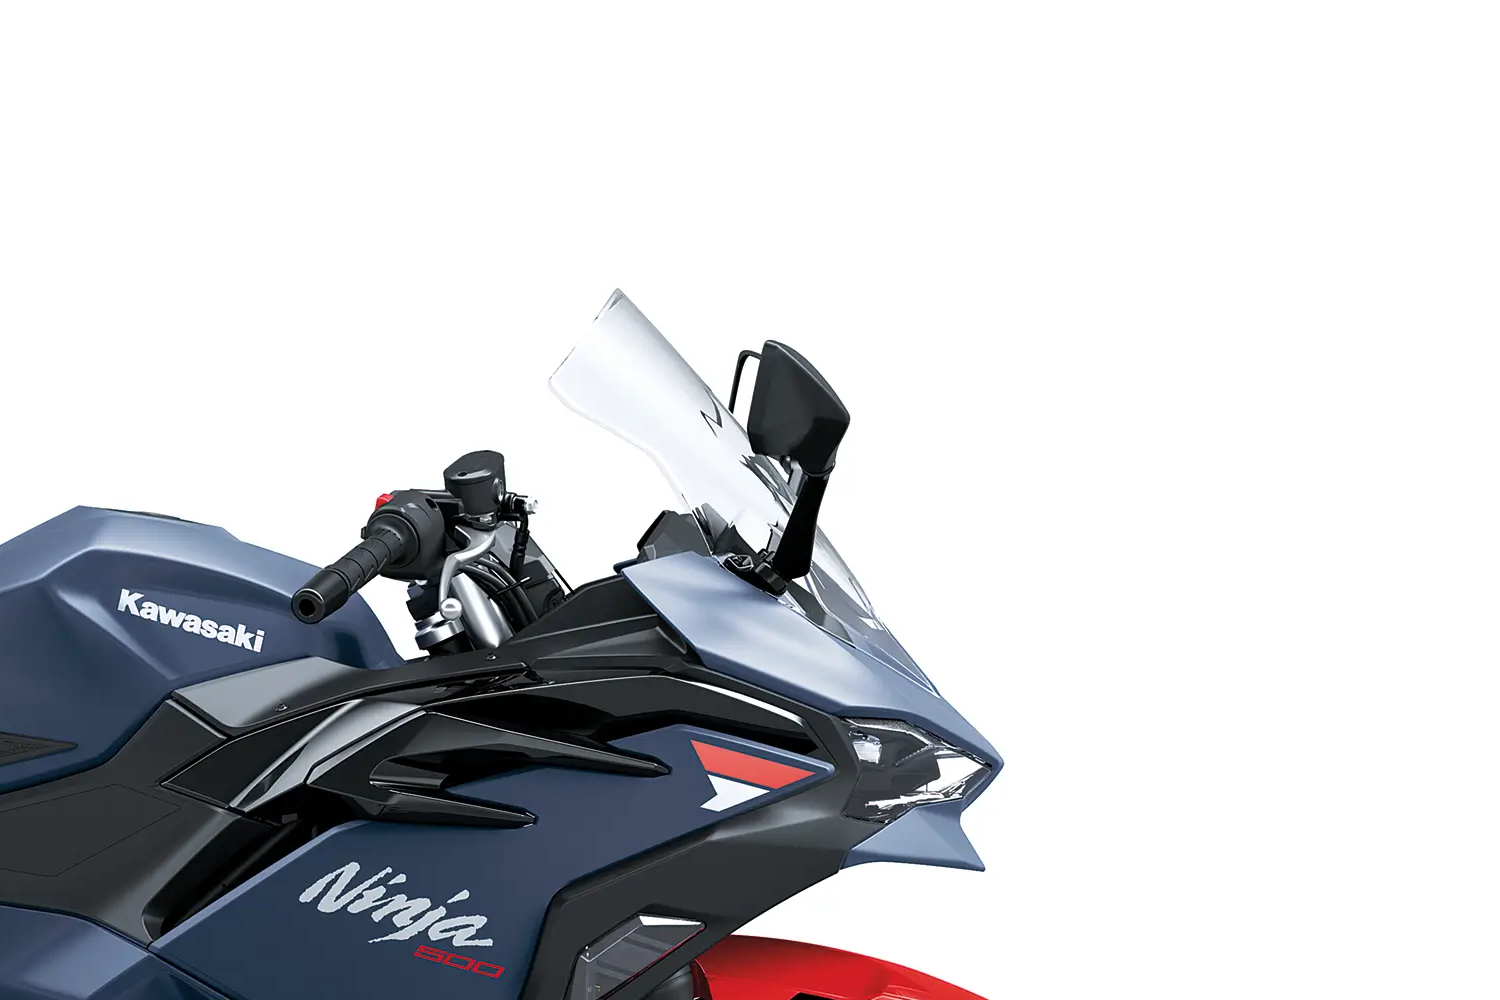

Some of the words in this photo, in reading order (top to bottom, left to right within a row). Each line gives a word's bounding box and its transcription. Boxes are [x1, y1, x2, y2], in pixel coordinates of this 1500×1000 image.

[117, 588, 266, 653] Kawasaki
[298, 861, 494, 947] Ninja
[413, 945, 505, 979] 500
